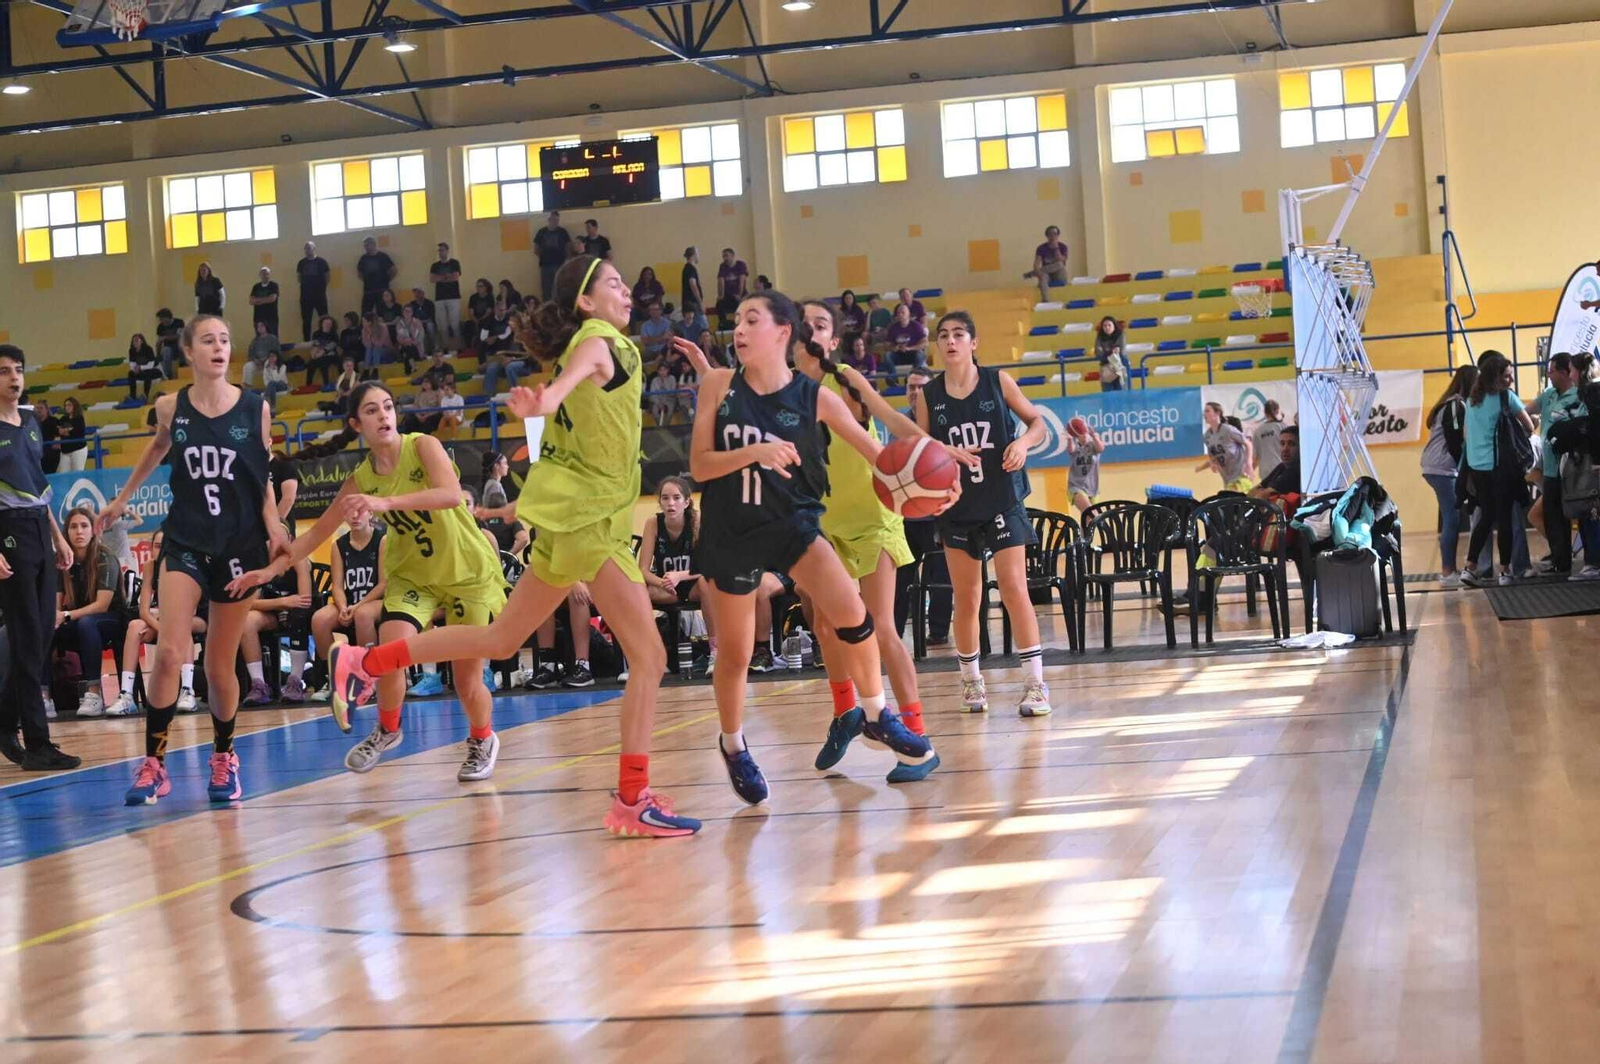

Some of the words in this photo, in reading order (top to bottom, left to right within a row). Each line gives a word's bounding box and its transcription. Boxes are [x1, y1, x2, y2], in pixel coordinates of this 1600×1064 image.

[948, 421, 995, 450] CDZ
[183, 445, 236, 481] CDZ
[204, 483, 221, 516] 6
[741, 467, 762, 506] 11
[415, 528, 434, 557] 5
[229, 558, 244, 579] 6
[346, 566, 374, 590] CDZ
[453, 597, 465, 618] 5
